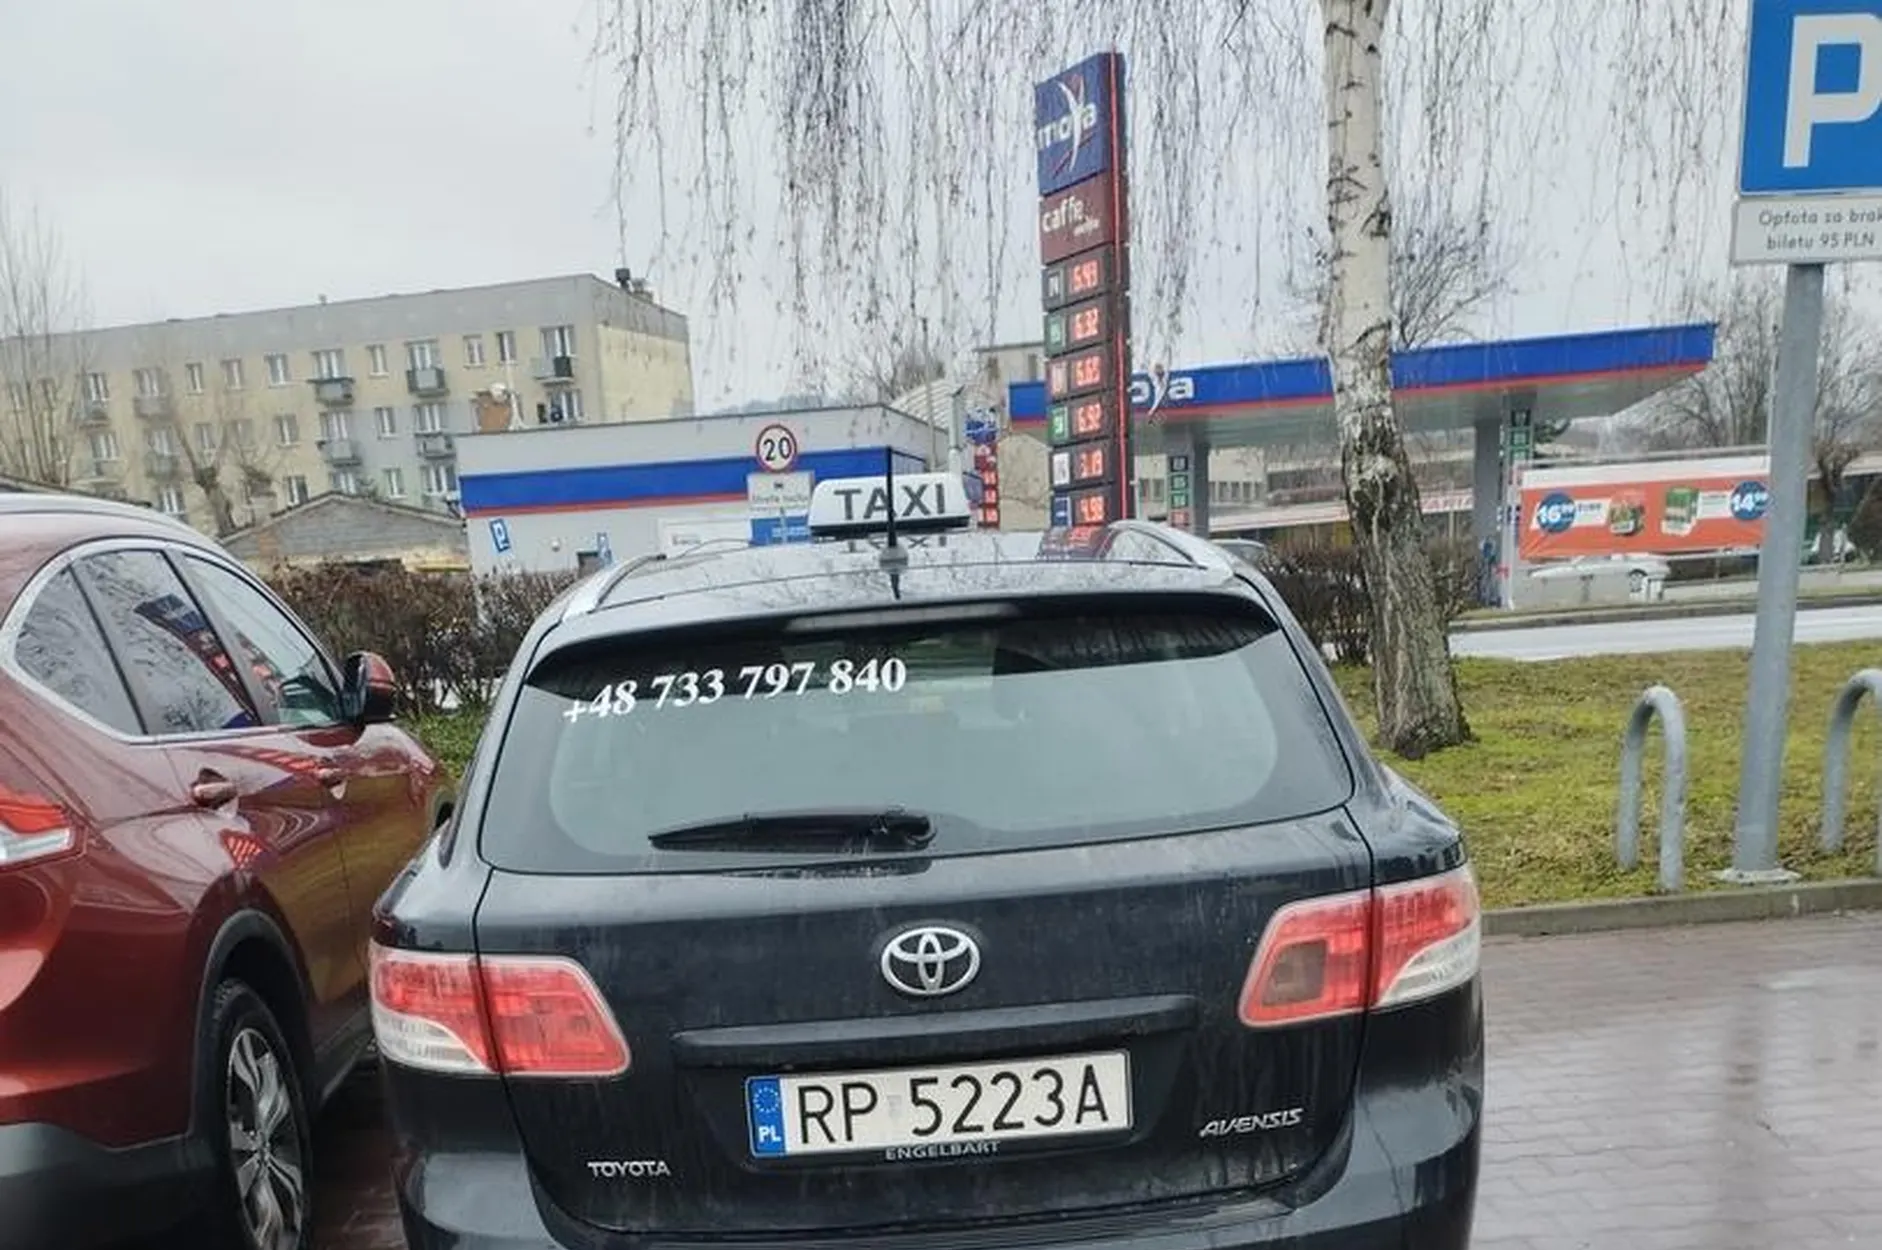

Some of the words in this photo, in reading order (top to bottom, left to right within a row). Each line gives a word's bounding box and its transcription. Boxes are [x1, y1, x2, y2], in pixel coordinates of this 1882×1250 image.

[1783, 13, 1882, 169] P
[1825, 212, 1842, 223] za
[1767, 233, 1814, 250] biletu
[1844, 231, 1875, 247] PLN
[1131, 364, 1195, 416] oya
[763, 436, 793, 461] 20
[834, 483, 946, 520] TAXI
[563, 680, 638, 723] +48
[651, 669, 726, 709] 733
[739, 661, 815, 699] 797
[829, 657, 906, 694] 840
[799, 1081, 878, 1144] RP
[909, 1063, 1109, 1137] 5223A
[758, 1125, 782, 1143] PL
[1198, 1108, 1303, 1137] AVENSIS
[885, 1140, 1000, 1160] ENGELBART
[587, 1160, 671, 1177] TOYOTA
